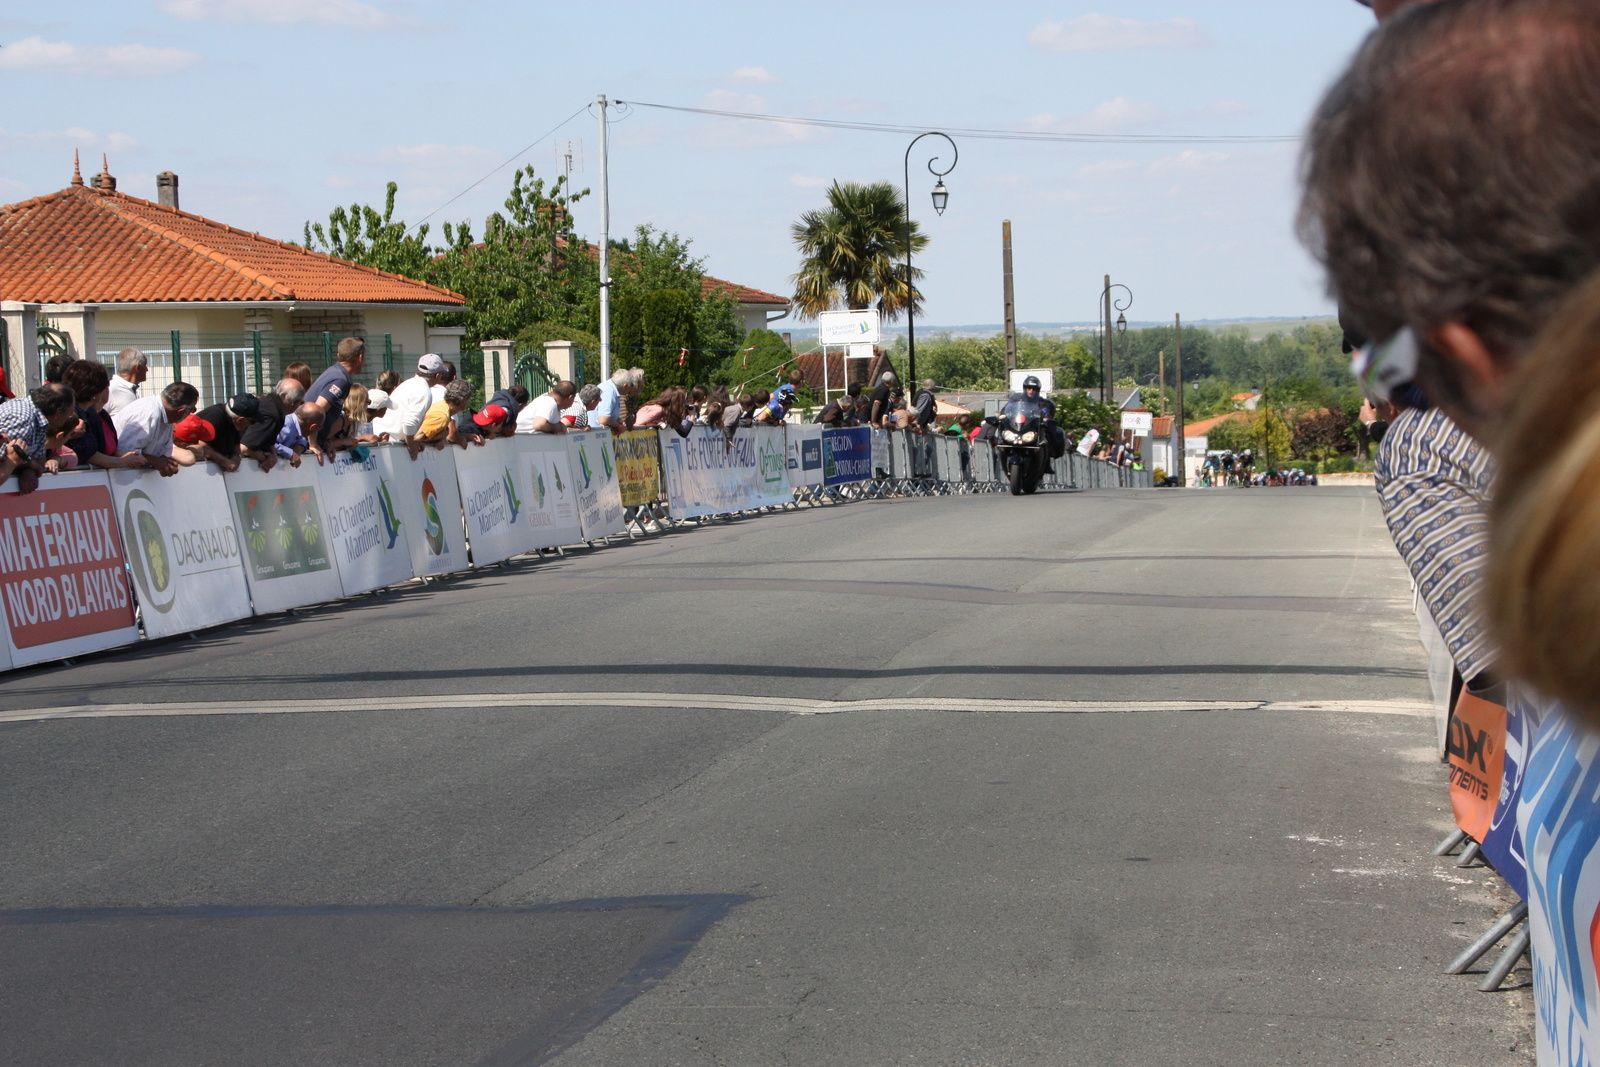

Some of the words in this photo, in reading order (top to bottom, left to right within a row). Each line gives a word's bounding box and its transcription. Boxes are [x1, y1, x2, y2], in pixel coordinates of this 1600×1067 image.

[328, 513, 340, 540] la
[338, 492, 376, 533] Charente
[474, 479, 502, 514] Charente
[0, 502, 118, 574] MATÉRIAUX
[478, 503, 506, 536] Maritime
[171, 525, 239, 567] DAGNAUD
[344, 523, 381, 564] Maritime
[5, 575, 63, 628] NORD
[59, 566, 128, 619] BLAYAIS
